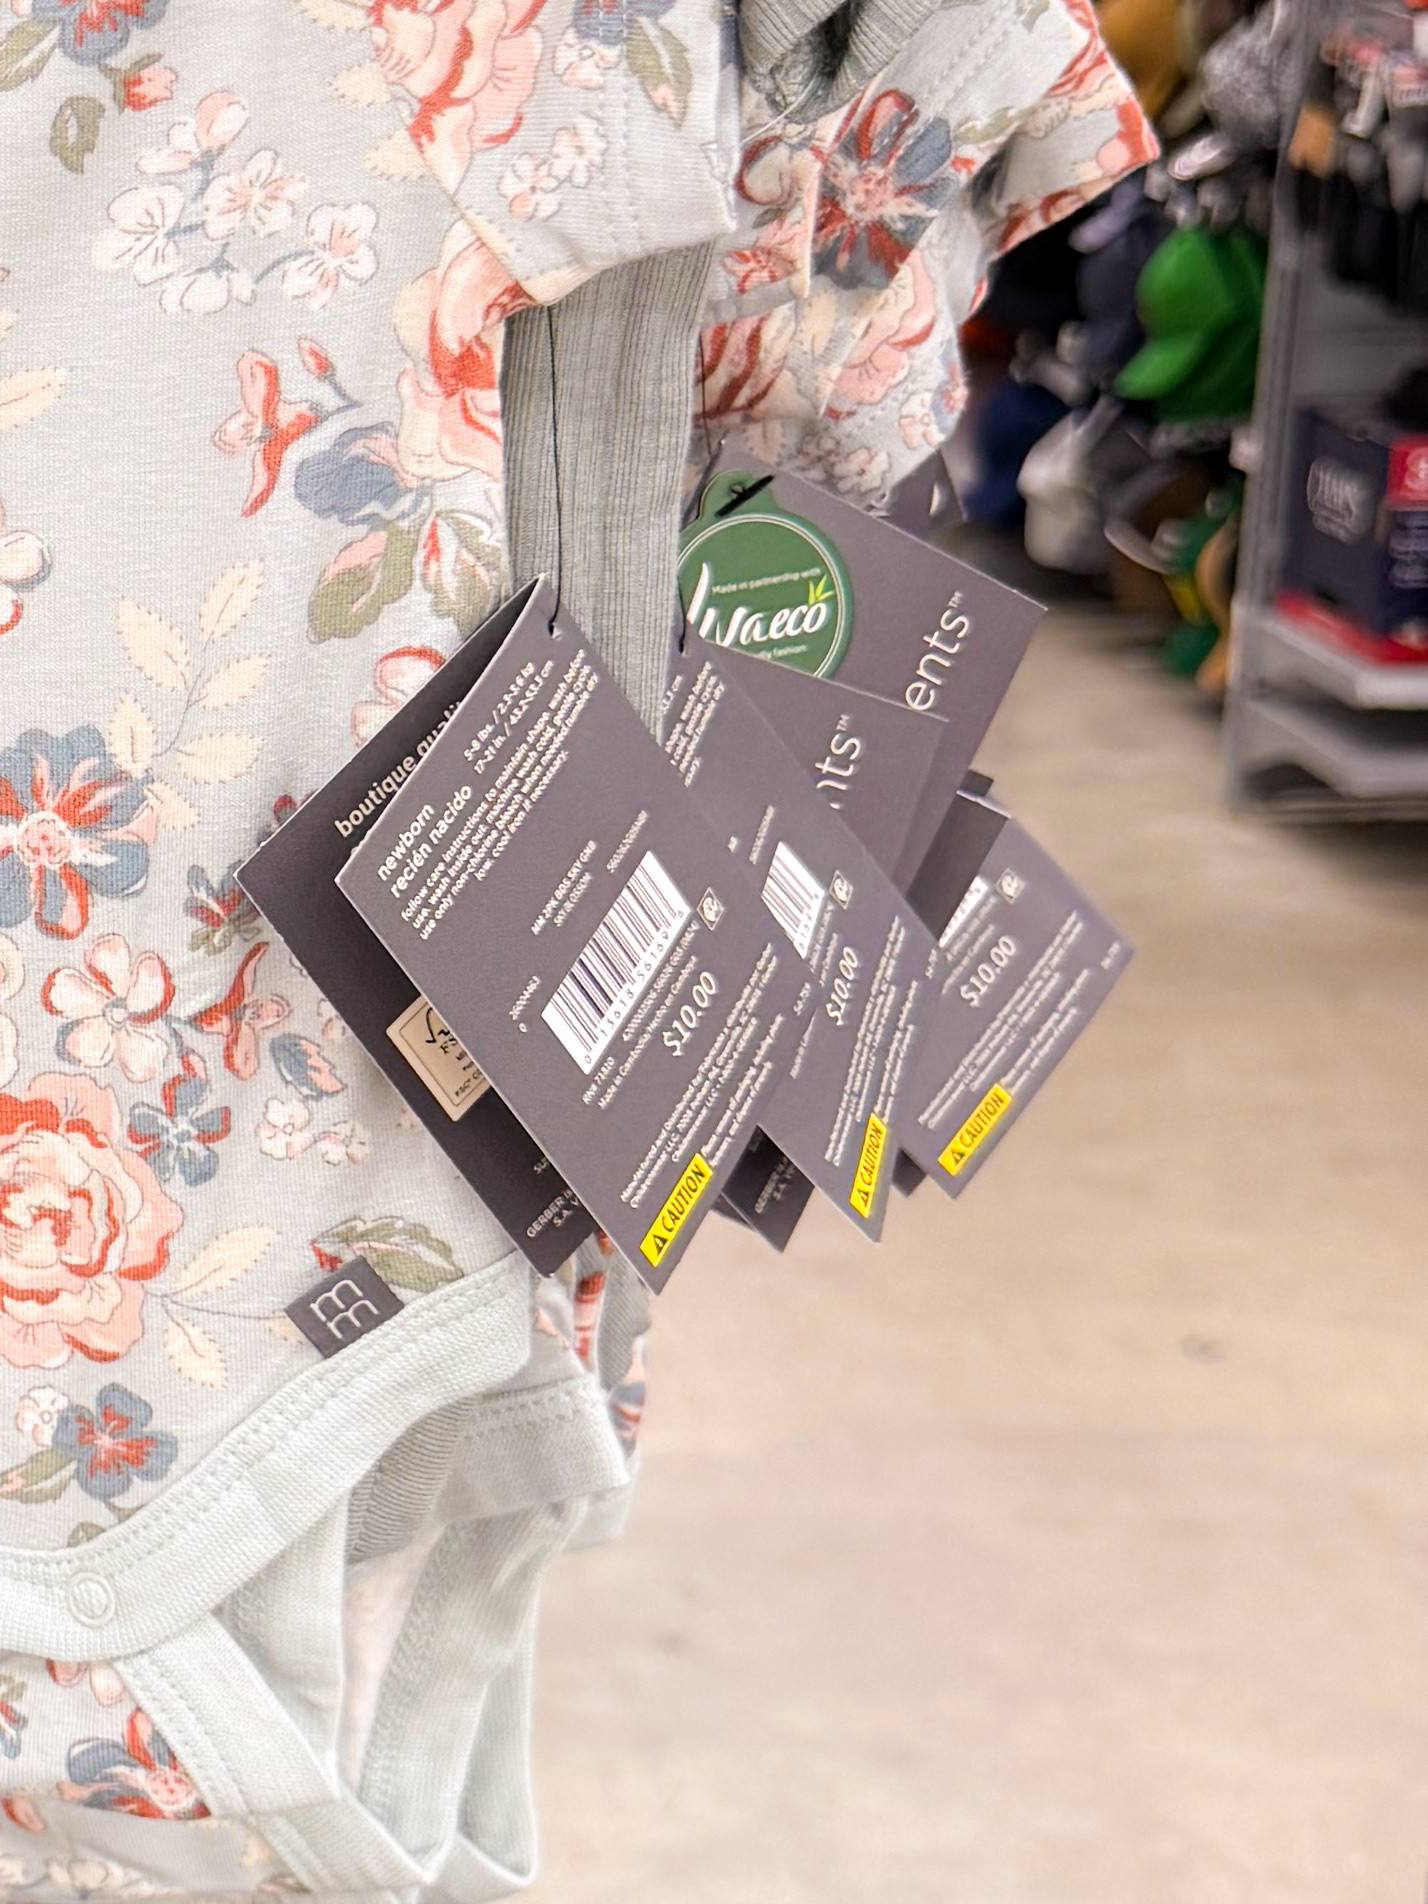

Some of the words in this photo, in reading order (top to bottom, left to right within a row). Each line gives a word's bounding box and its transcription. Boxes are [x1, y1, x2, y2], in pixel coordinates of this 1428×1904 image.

[712, 583, 737, 595] Made
[799, 567, 822, 580] with
[539, 656, 556, 682] cm
[334, 754, 417, 838] boutique
[400, 881, 429, 924] follow
[425, 858, 447, 890] care
[441, 794, 489, 867] instructions
[484, 784, 498, 804] to
[492, 737, 529, 793] maintain
[546, 678, 568, 712] wash
[561, 645, 588, 686] before
[374, 796, 436, 886] newborn
[388, 836, 433, 902] recién
[426, 777, 474, 848] nacido
[418, 915, 437, 942] use
[433, 892, 455, 924] only
[449, 823, 500, 901] non-chlorine
[494, 788, 524, 834] bleach
[519, 760, 544, 797] when
[427, 872, 452, 908] wash
[446, 840, 474, 881] inside
[484, 772, 520, 827] machine
[515, 747, 538, 782] wash
[489, 827, 511, 861] cool
[506, 806, 526, 836] iron
[827, 946, 860, 1027] $10.00
[959, 934, 1018, 1008] $10.00
[660, 968, 718, 1058] $10.00
[597, 1080, 616, 1111] Made
[959, 1092, 1005, 1150] CAUTION
[861, 1121, 884, 1184] CAUTION
[658, 1158, 705, 1238] CAUTION
